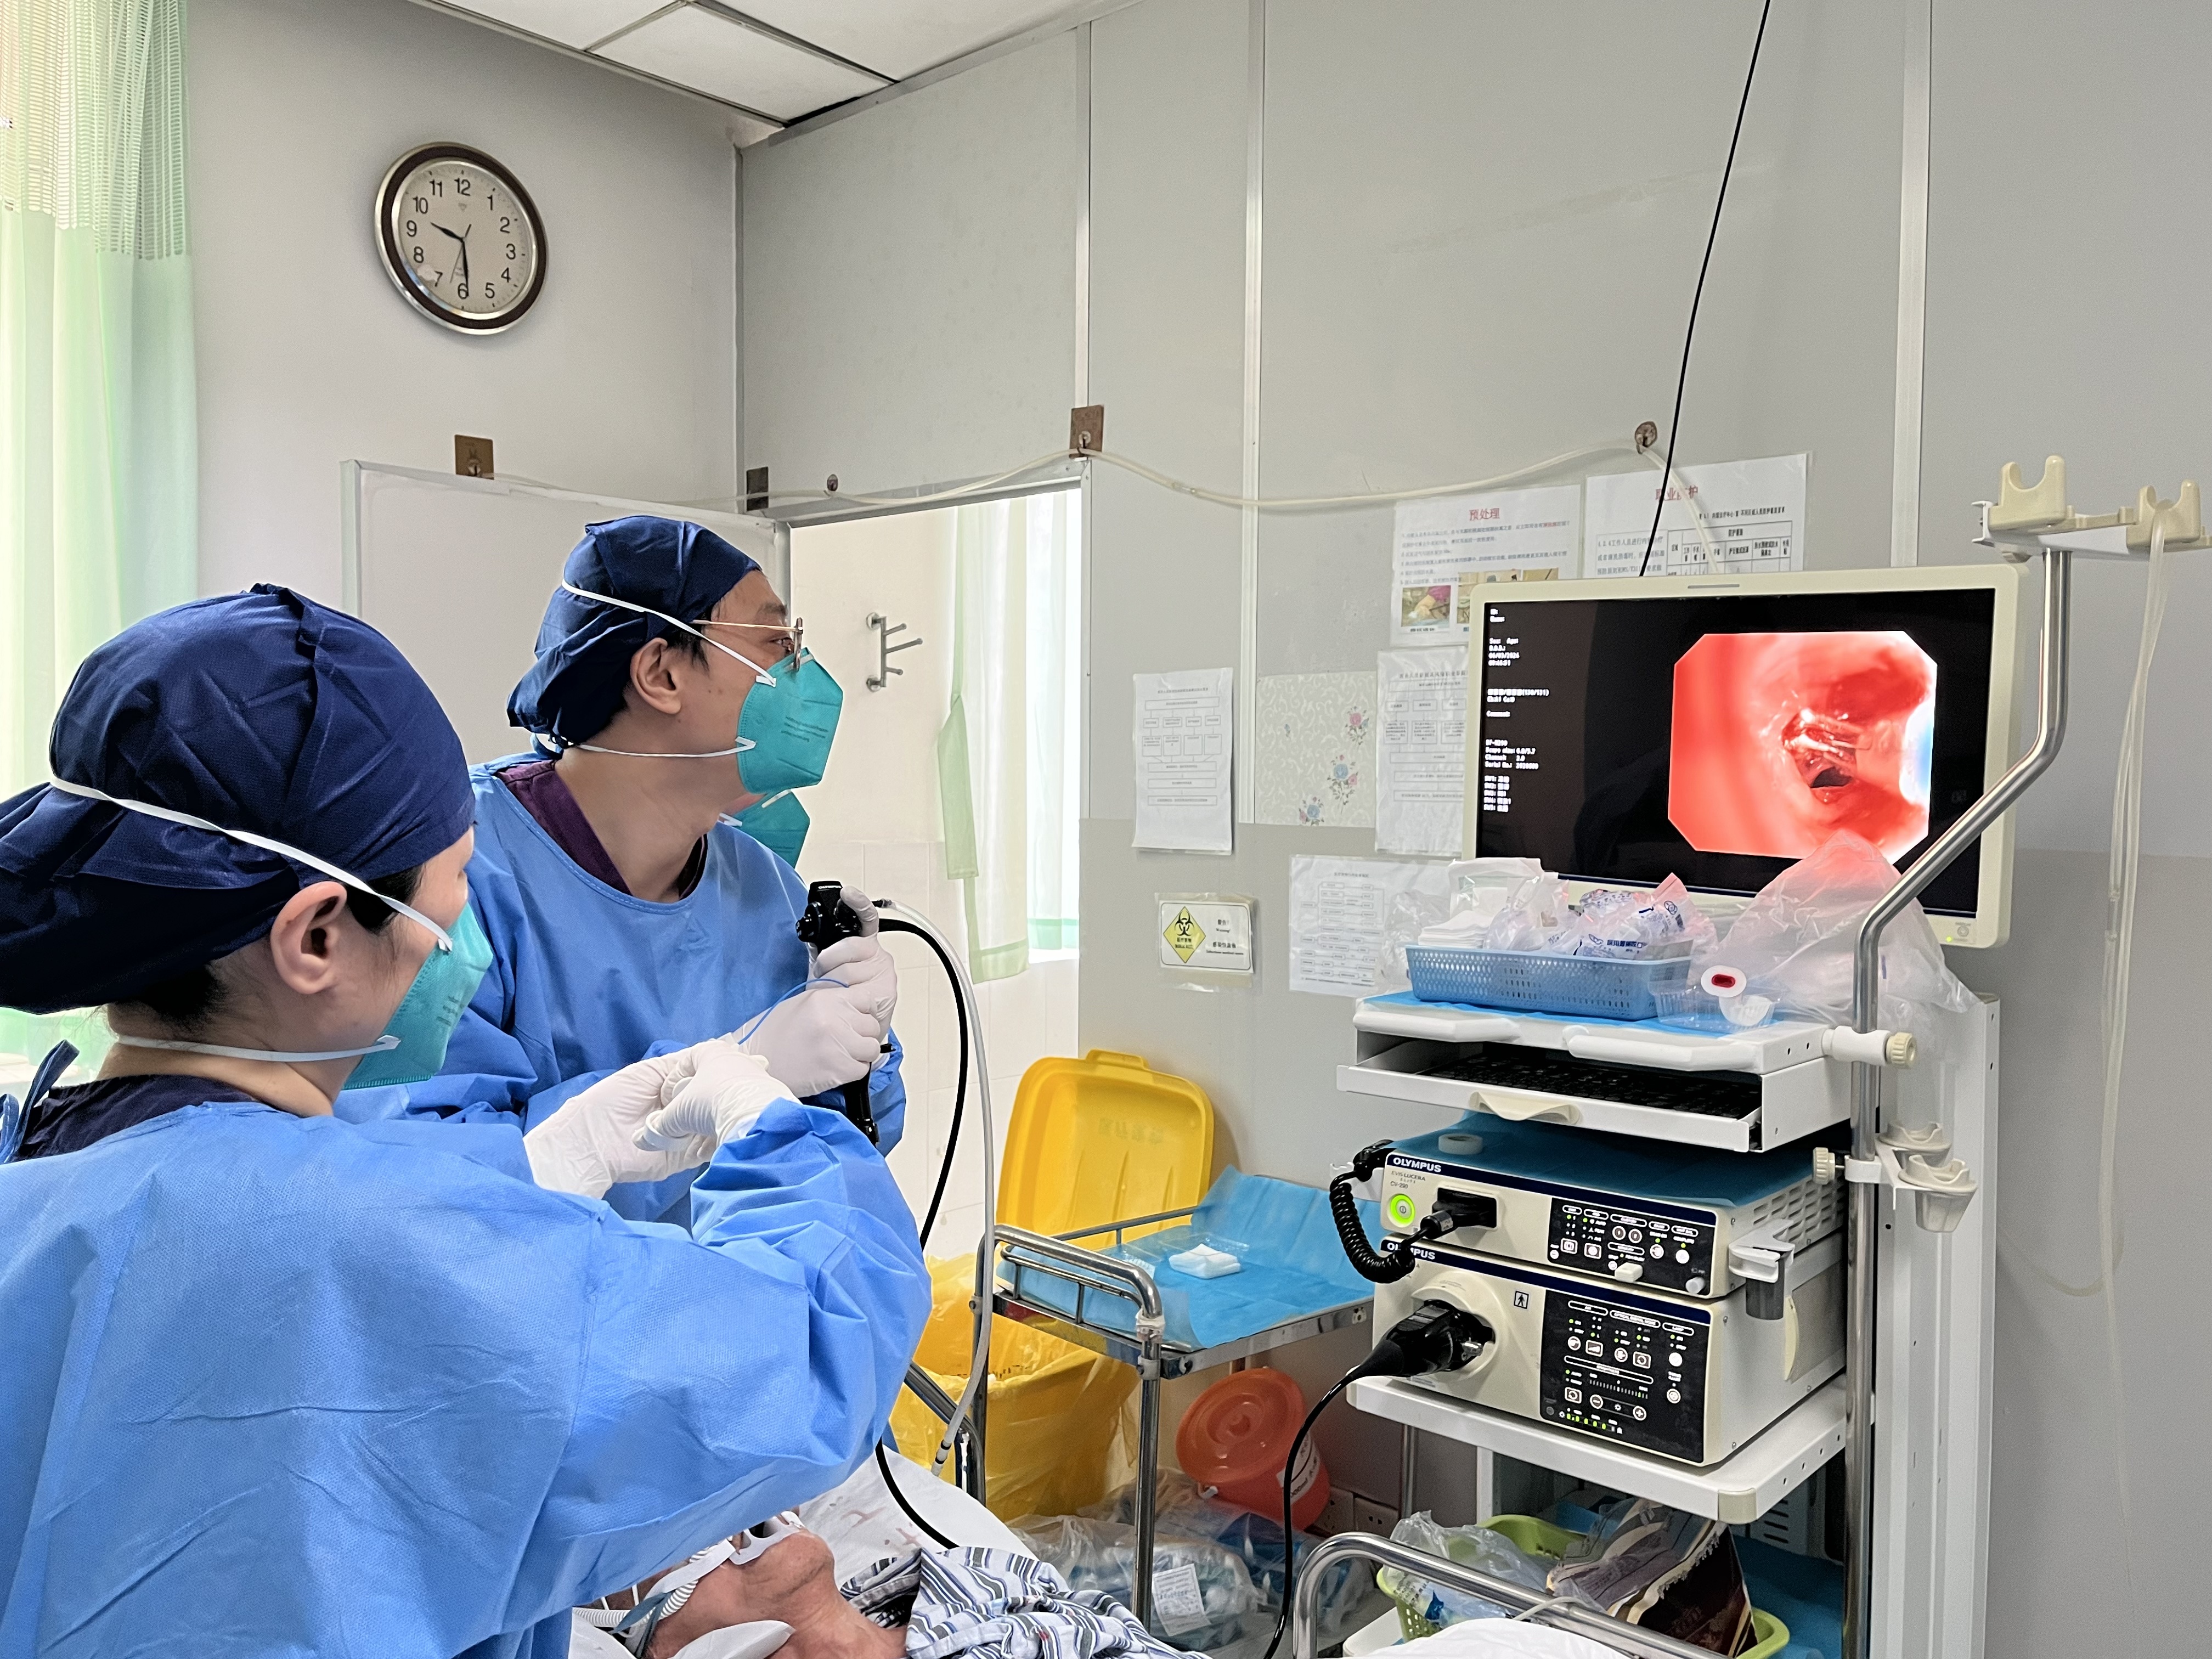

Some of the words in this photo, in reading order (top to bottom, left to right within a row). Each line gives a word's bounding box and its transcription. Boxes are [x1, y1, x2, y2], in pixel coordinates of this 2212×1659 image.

[430, 180, 443, 198] 11
[454, 178, 471, 196] 12
[413, 196, 428, 214] 10
[487, 195, 493, 211] 1
[407, 220, 417, 236] 9
[500, 217, 510, 233] 2
[413, 246, 424, 263] 8
[506, 243, 516, 259] 3
[434, 270, 443, 287] 7
[501, 267, 511, 283] 4
[458, 283, 469, 300] 6
[485, 282, 495, 298] 5
[1469, 507, 1500, 521] 预处理
[1393, 1157, 1442, 1173] OLYMPUS
[1403, 1173, 1426, 1181] LUCERA
